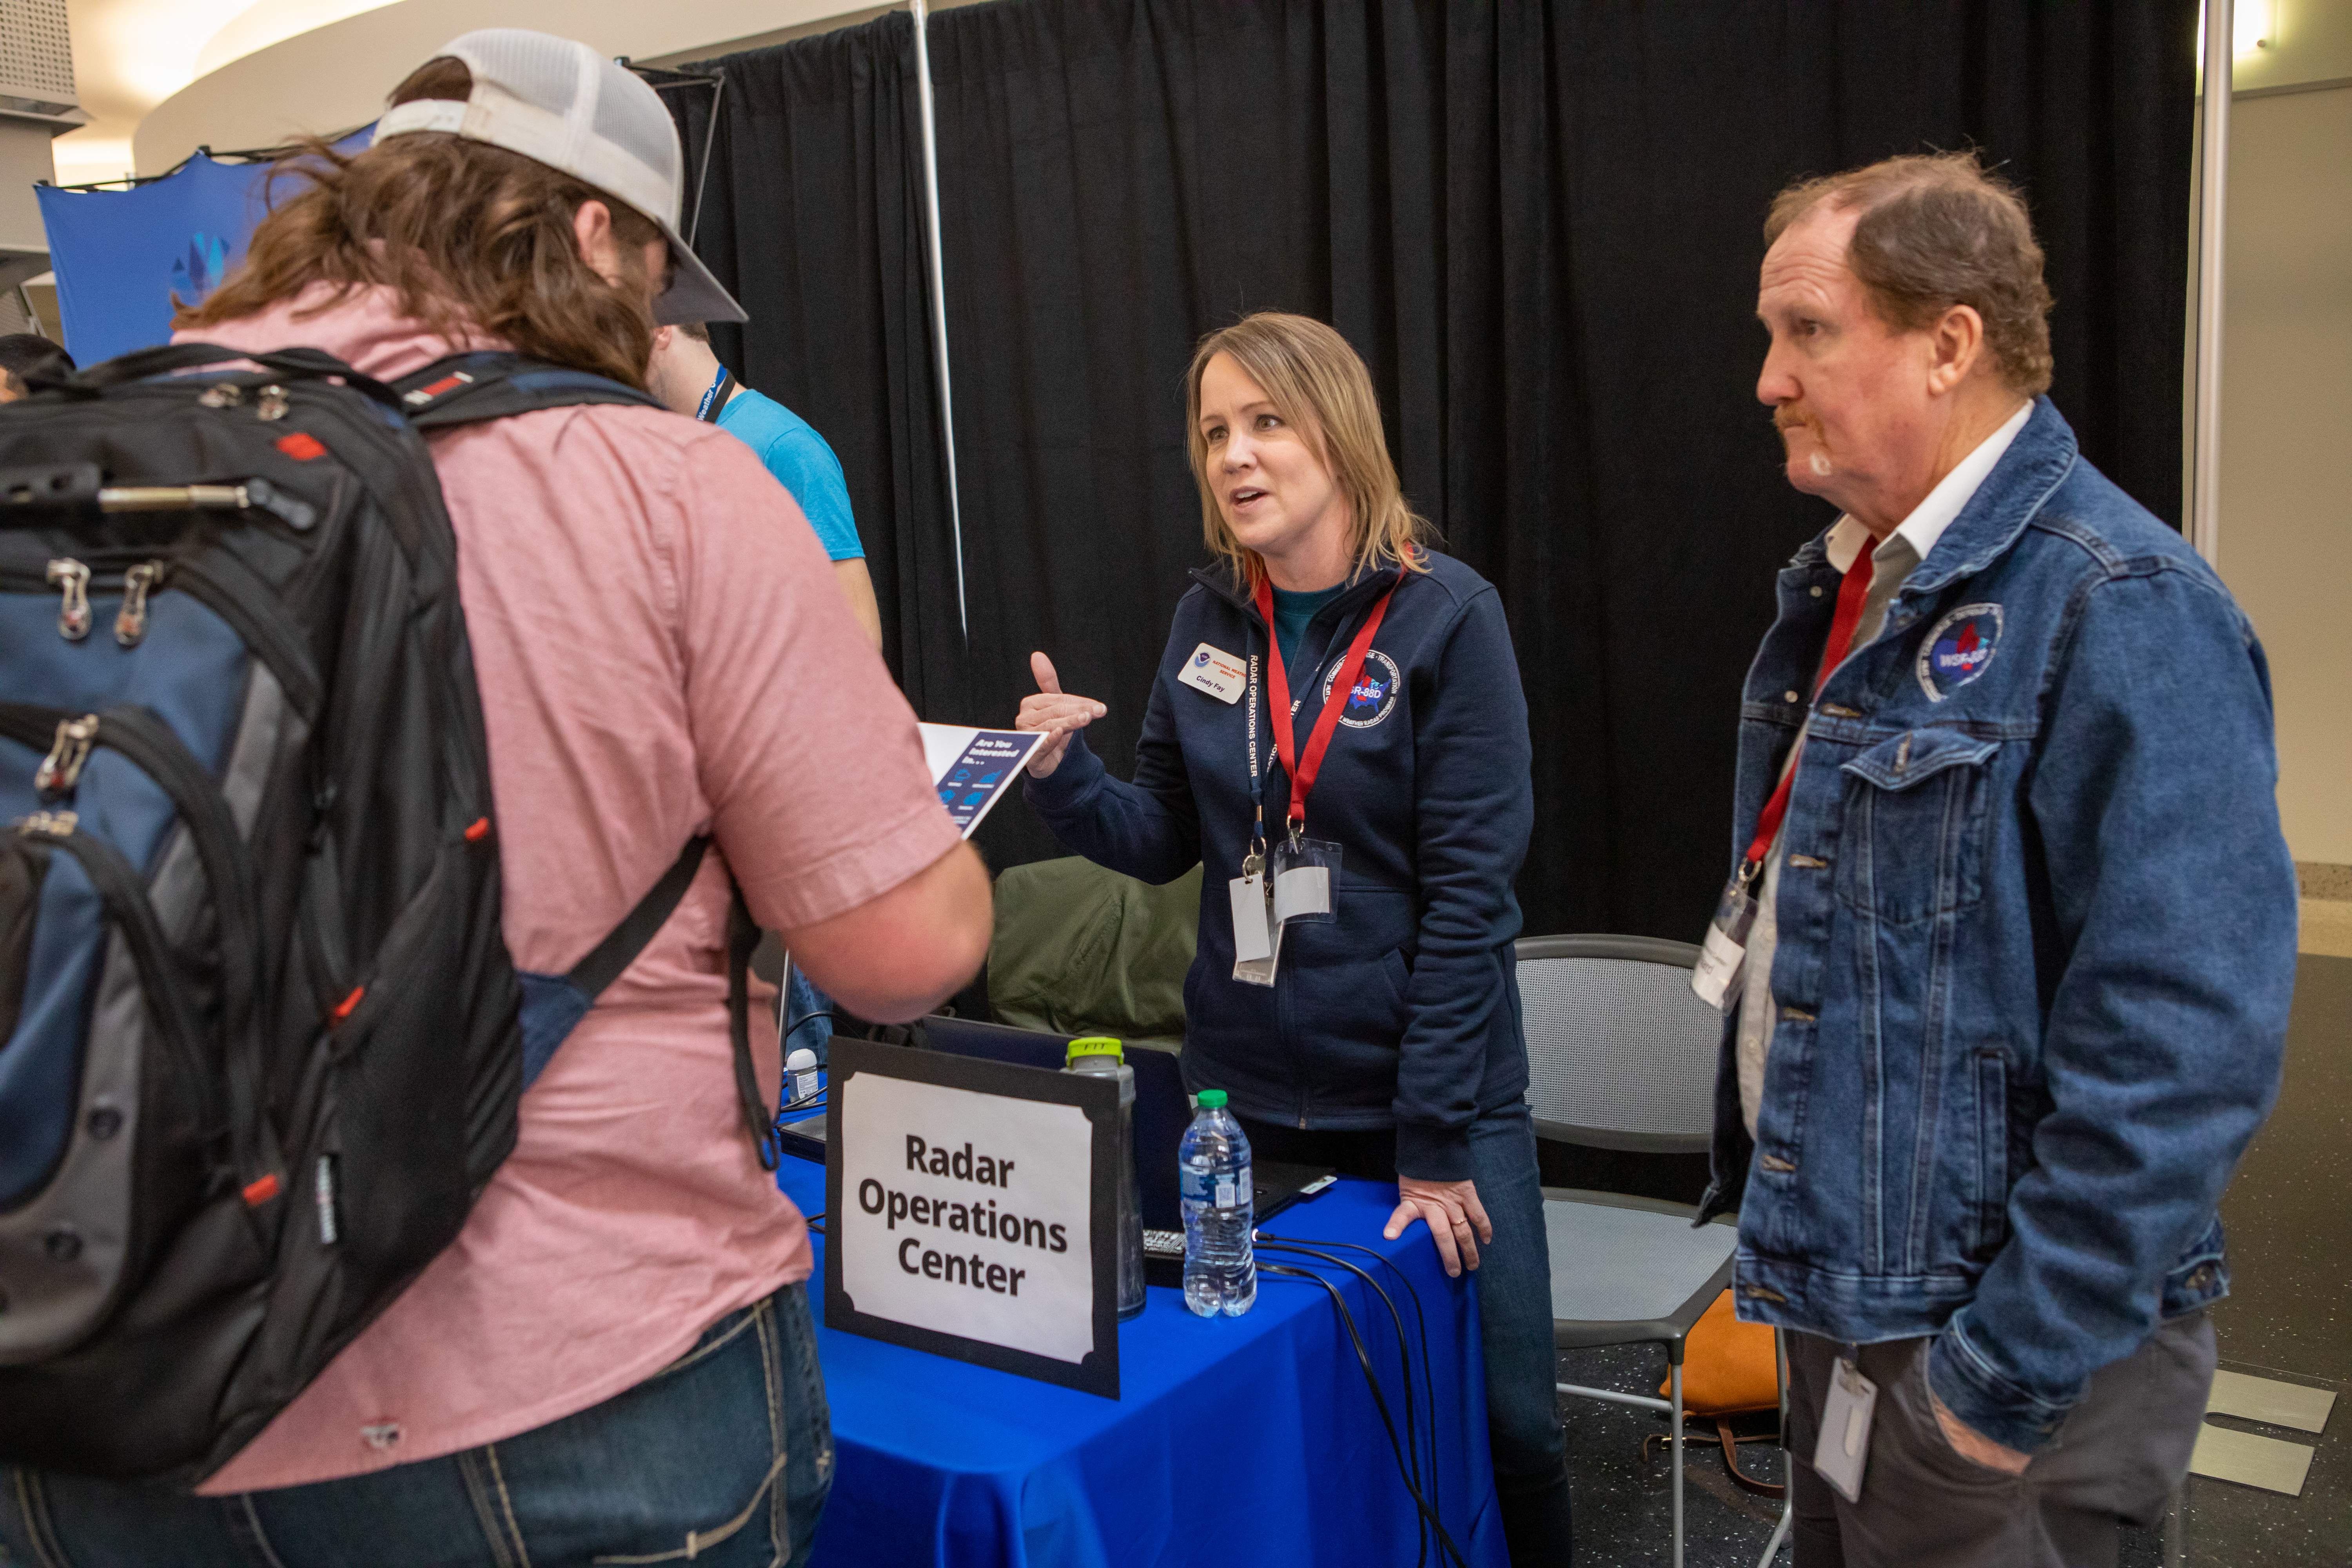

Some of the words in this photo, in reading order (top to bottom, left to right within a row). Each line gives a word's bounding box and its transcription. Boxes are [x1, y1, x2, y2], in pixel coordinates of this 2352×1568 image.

[697, 389, 713, 421] Weather
[1196, 675, 1213, 687] Cindy
[1214, 683, 1225, 692] Fay
[1212, 660, 1230, 671] NATIONAL
[1231, 668, 1246, 678] WEATHE
[1220, 670, 1236, 679] SERVICE
[1250, 655, 1258, 684] RADAR
[1378, 655, 1398, 694] TRANSPORTATION
[1350, 686, 1381, 699] SR-88D
[1249, 686, 1257, 740] OPERATIONS
[1364, 716, 1379, 725] RADAR
[1378, 697, 1394, 718] PROGRAM
[969, 748, 1020, 757] Interested
[975, 739, 994, 748] Are
[995, 740, 1013, 748] You
[1249, 741, 1258, 777] CENTER
[906, 1134, 1014, 1188] Radar
[858, 1178, 1068, 1253] Operations
[898, 1238, 1025, 1296] Center
